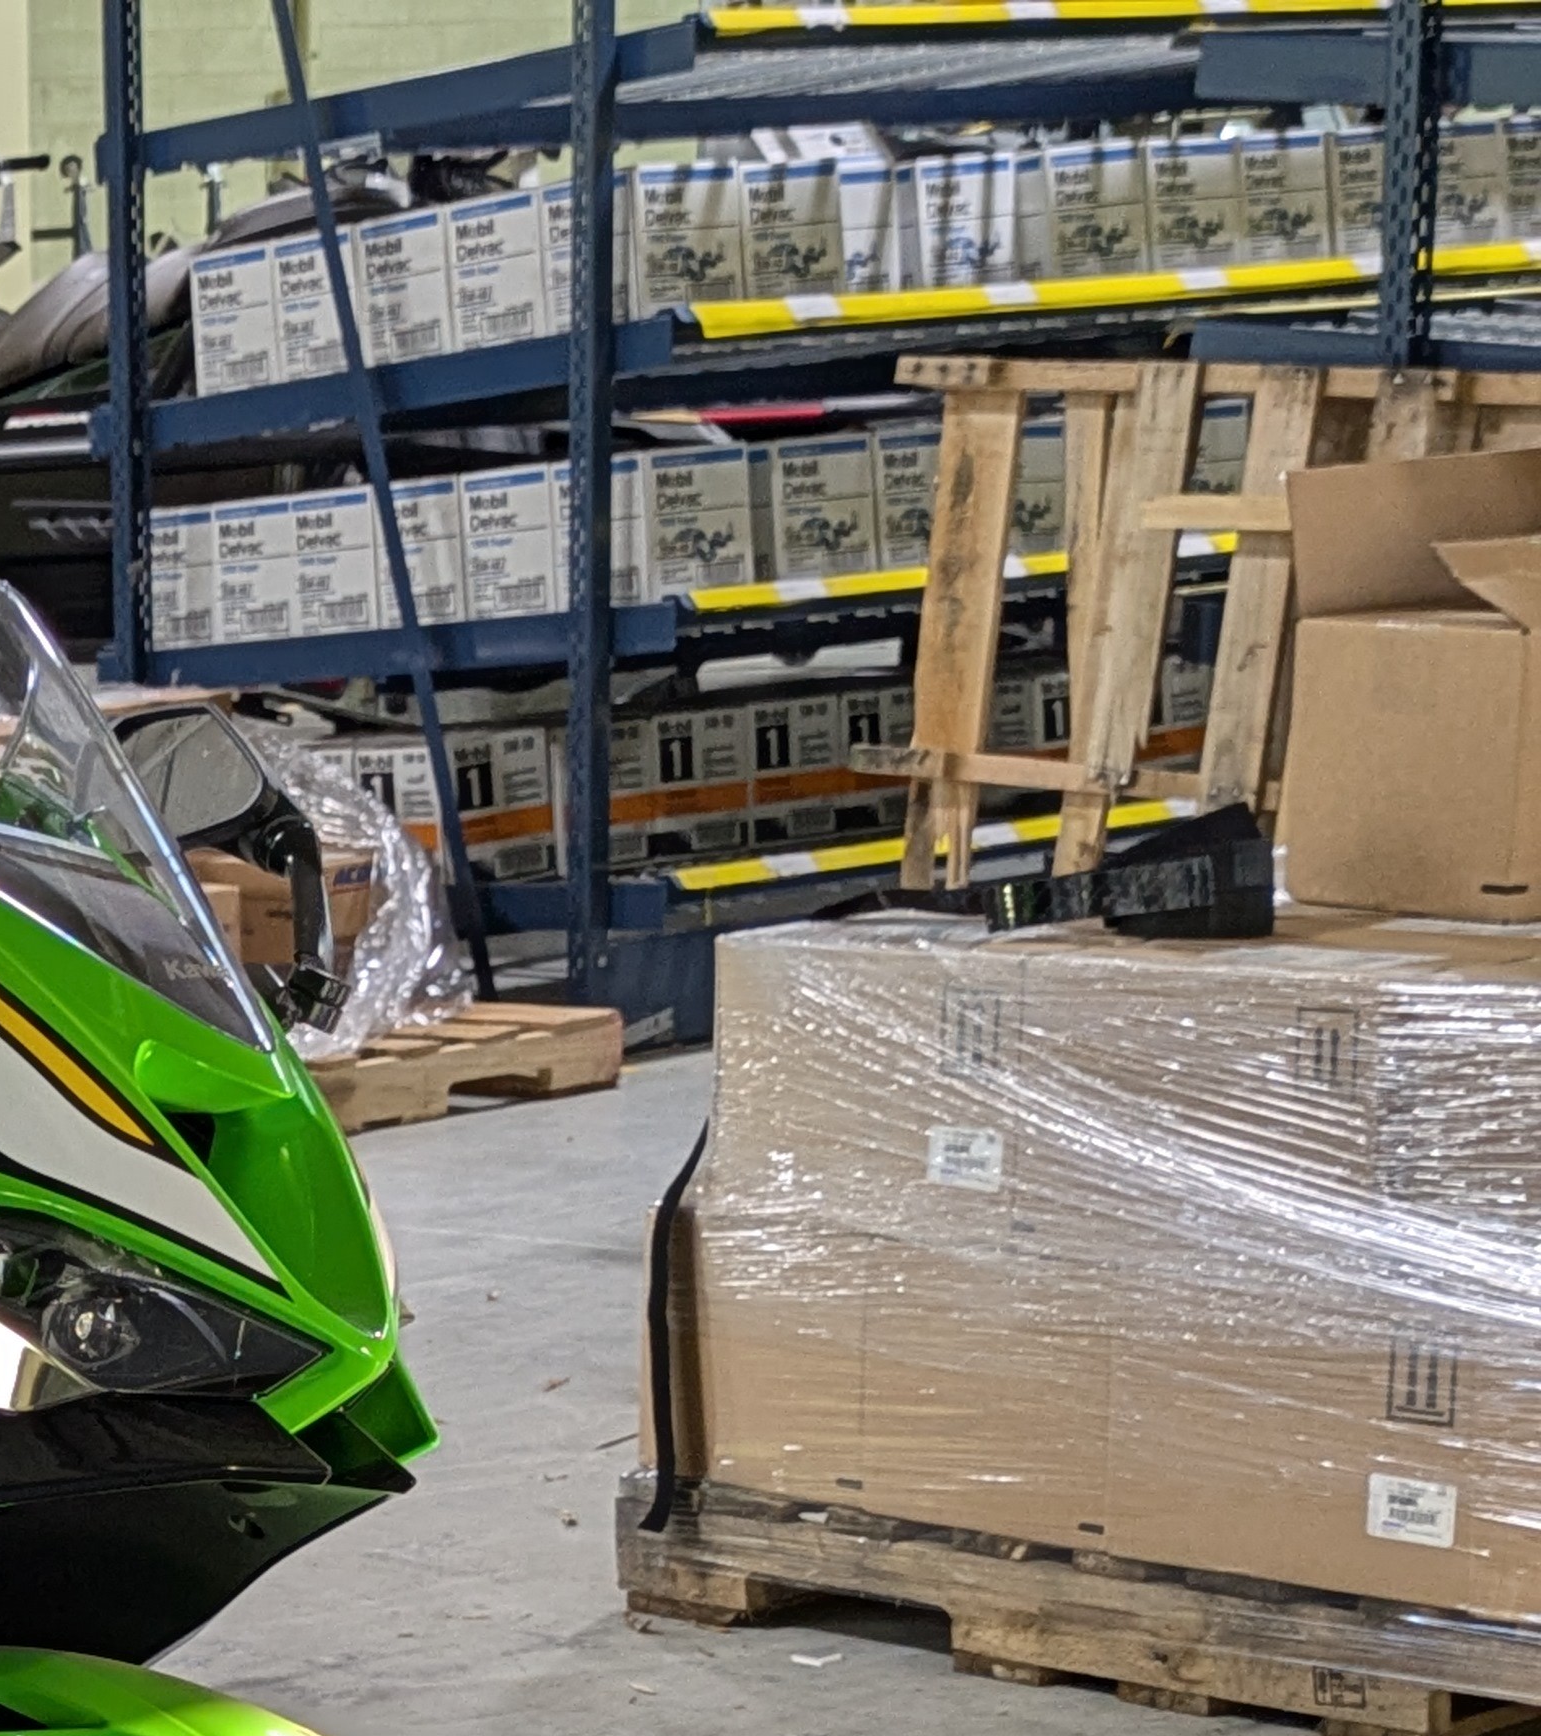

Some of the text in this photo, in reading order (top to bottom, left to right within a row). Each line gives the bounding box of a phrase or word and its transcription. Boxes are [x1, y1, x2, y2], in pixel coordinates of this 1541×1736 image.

[456, 218, 494, 240] Mobil
[469, 492, 508, 511] Mobil
[219, 521, 255, 540] Mobil
[296, 512, 332, 531] Mobil
[470, 513, 517, 534] Delvac
